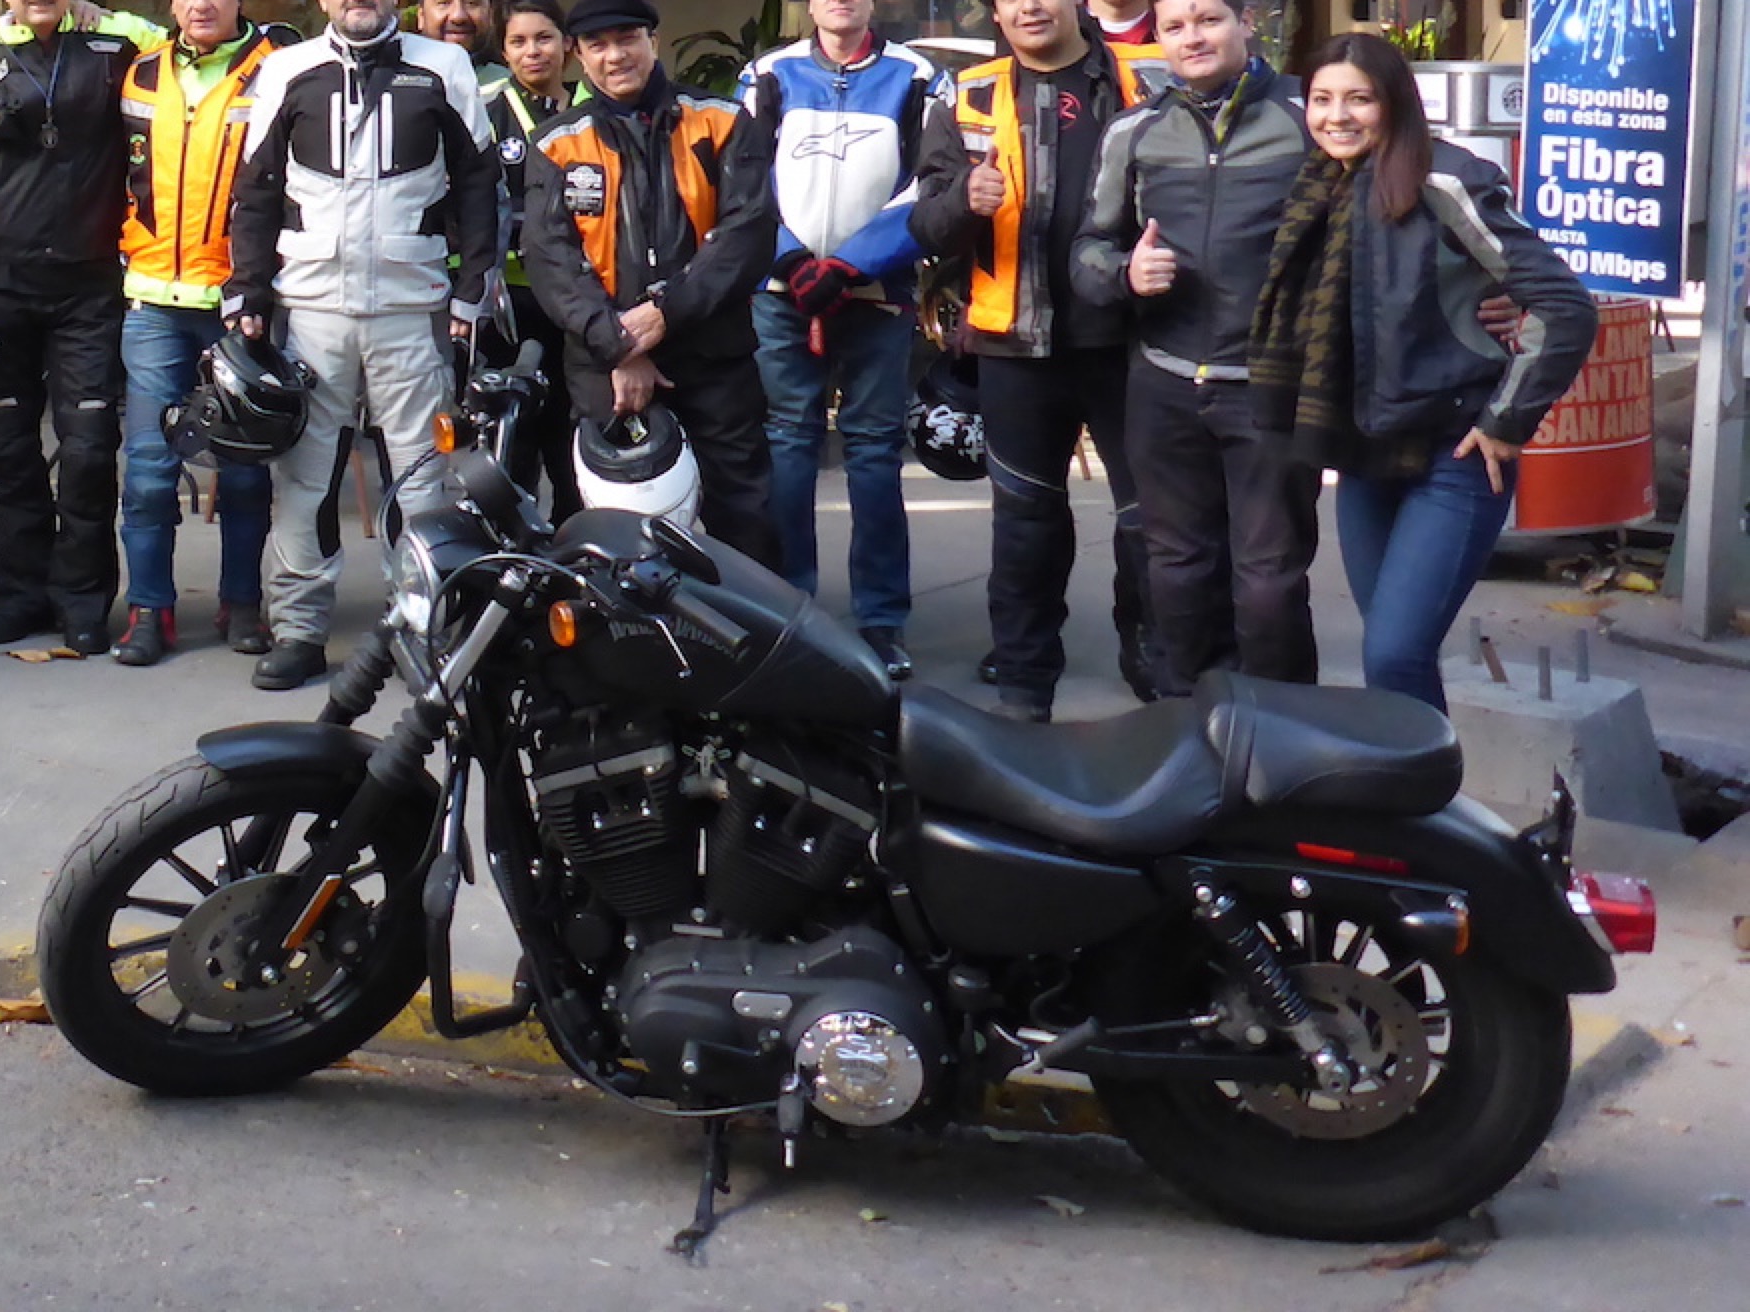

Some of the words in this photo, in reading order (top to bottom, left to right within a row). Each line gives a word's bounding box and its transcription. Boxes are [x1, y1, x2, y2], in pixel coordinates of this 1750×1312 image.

[1543, 82, 1670, 111] Disponible
[1543, 109, 1567, 124] en
[1571, 109, 1613, 127] esta
[1618, 113, 1667, 131] zona
[1539, 135, 1666, 186] Fibra
[1536, 176, 1662, 228] Óptica
[1537, 228, 1588, 246] HASTA
